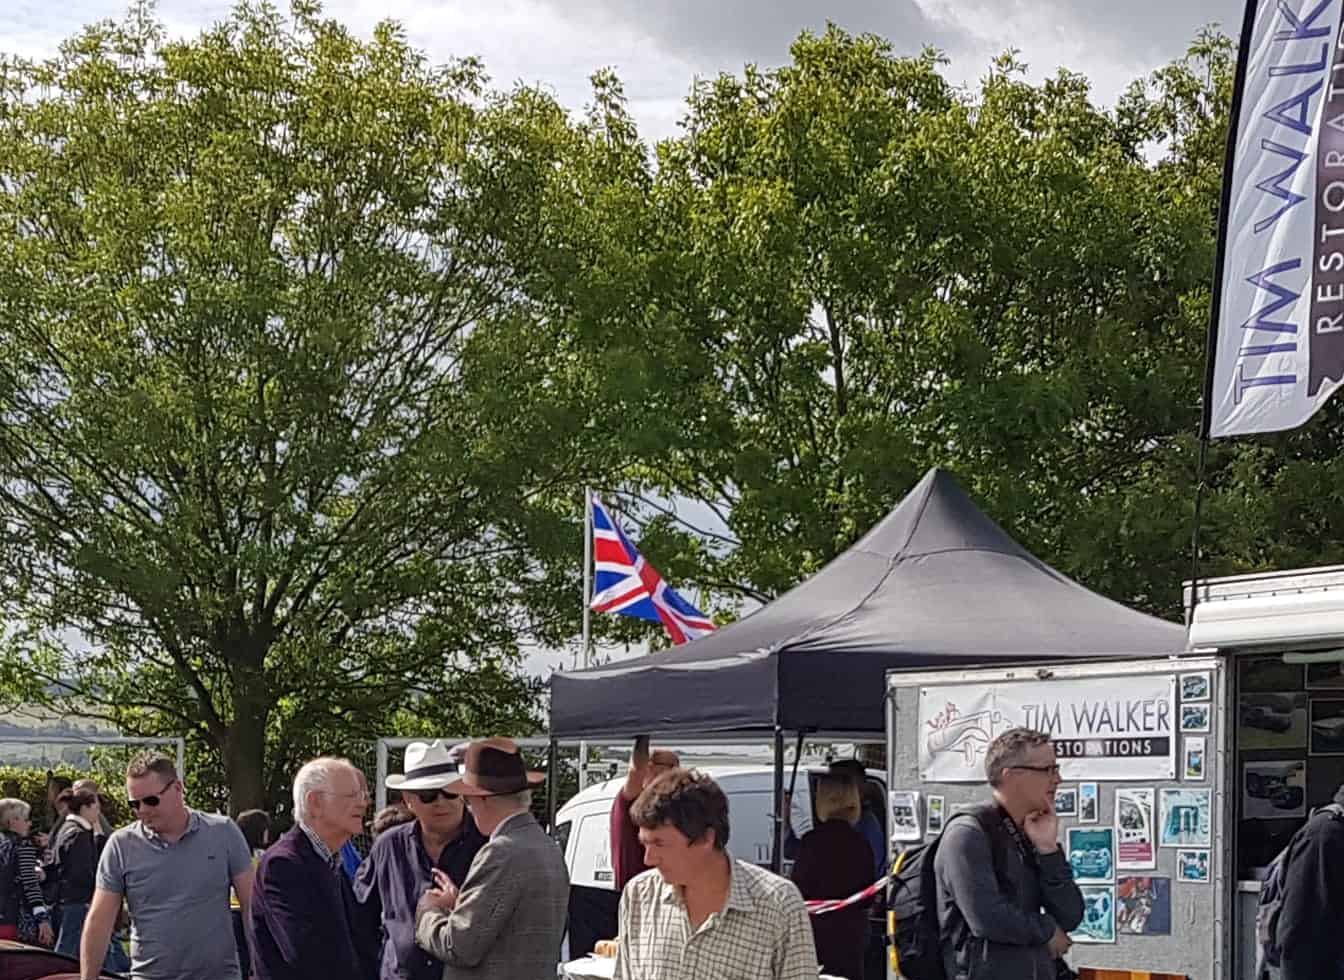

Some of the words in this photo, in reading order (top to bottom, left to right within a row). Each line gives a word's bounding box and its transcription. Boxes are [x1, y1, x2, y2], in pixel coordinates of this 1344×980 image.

[1234, 257, 1302, 404] TIM
[1022, 702, 1062, 735] TIM
[1070, 699, 1170, 734] WALKER
